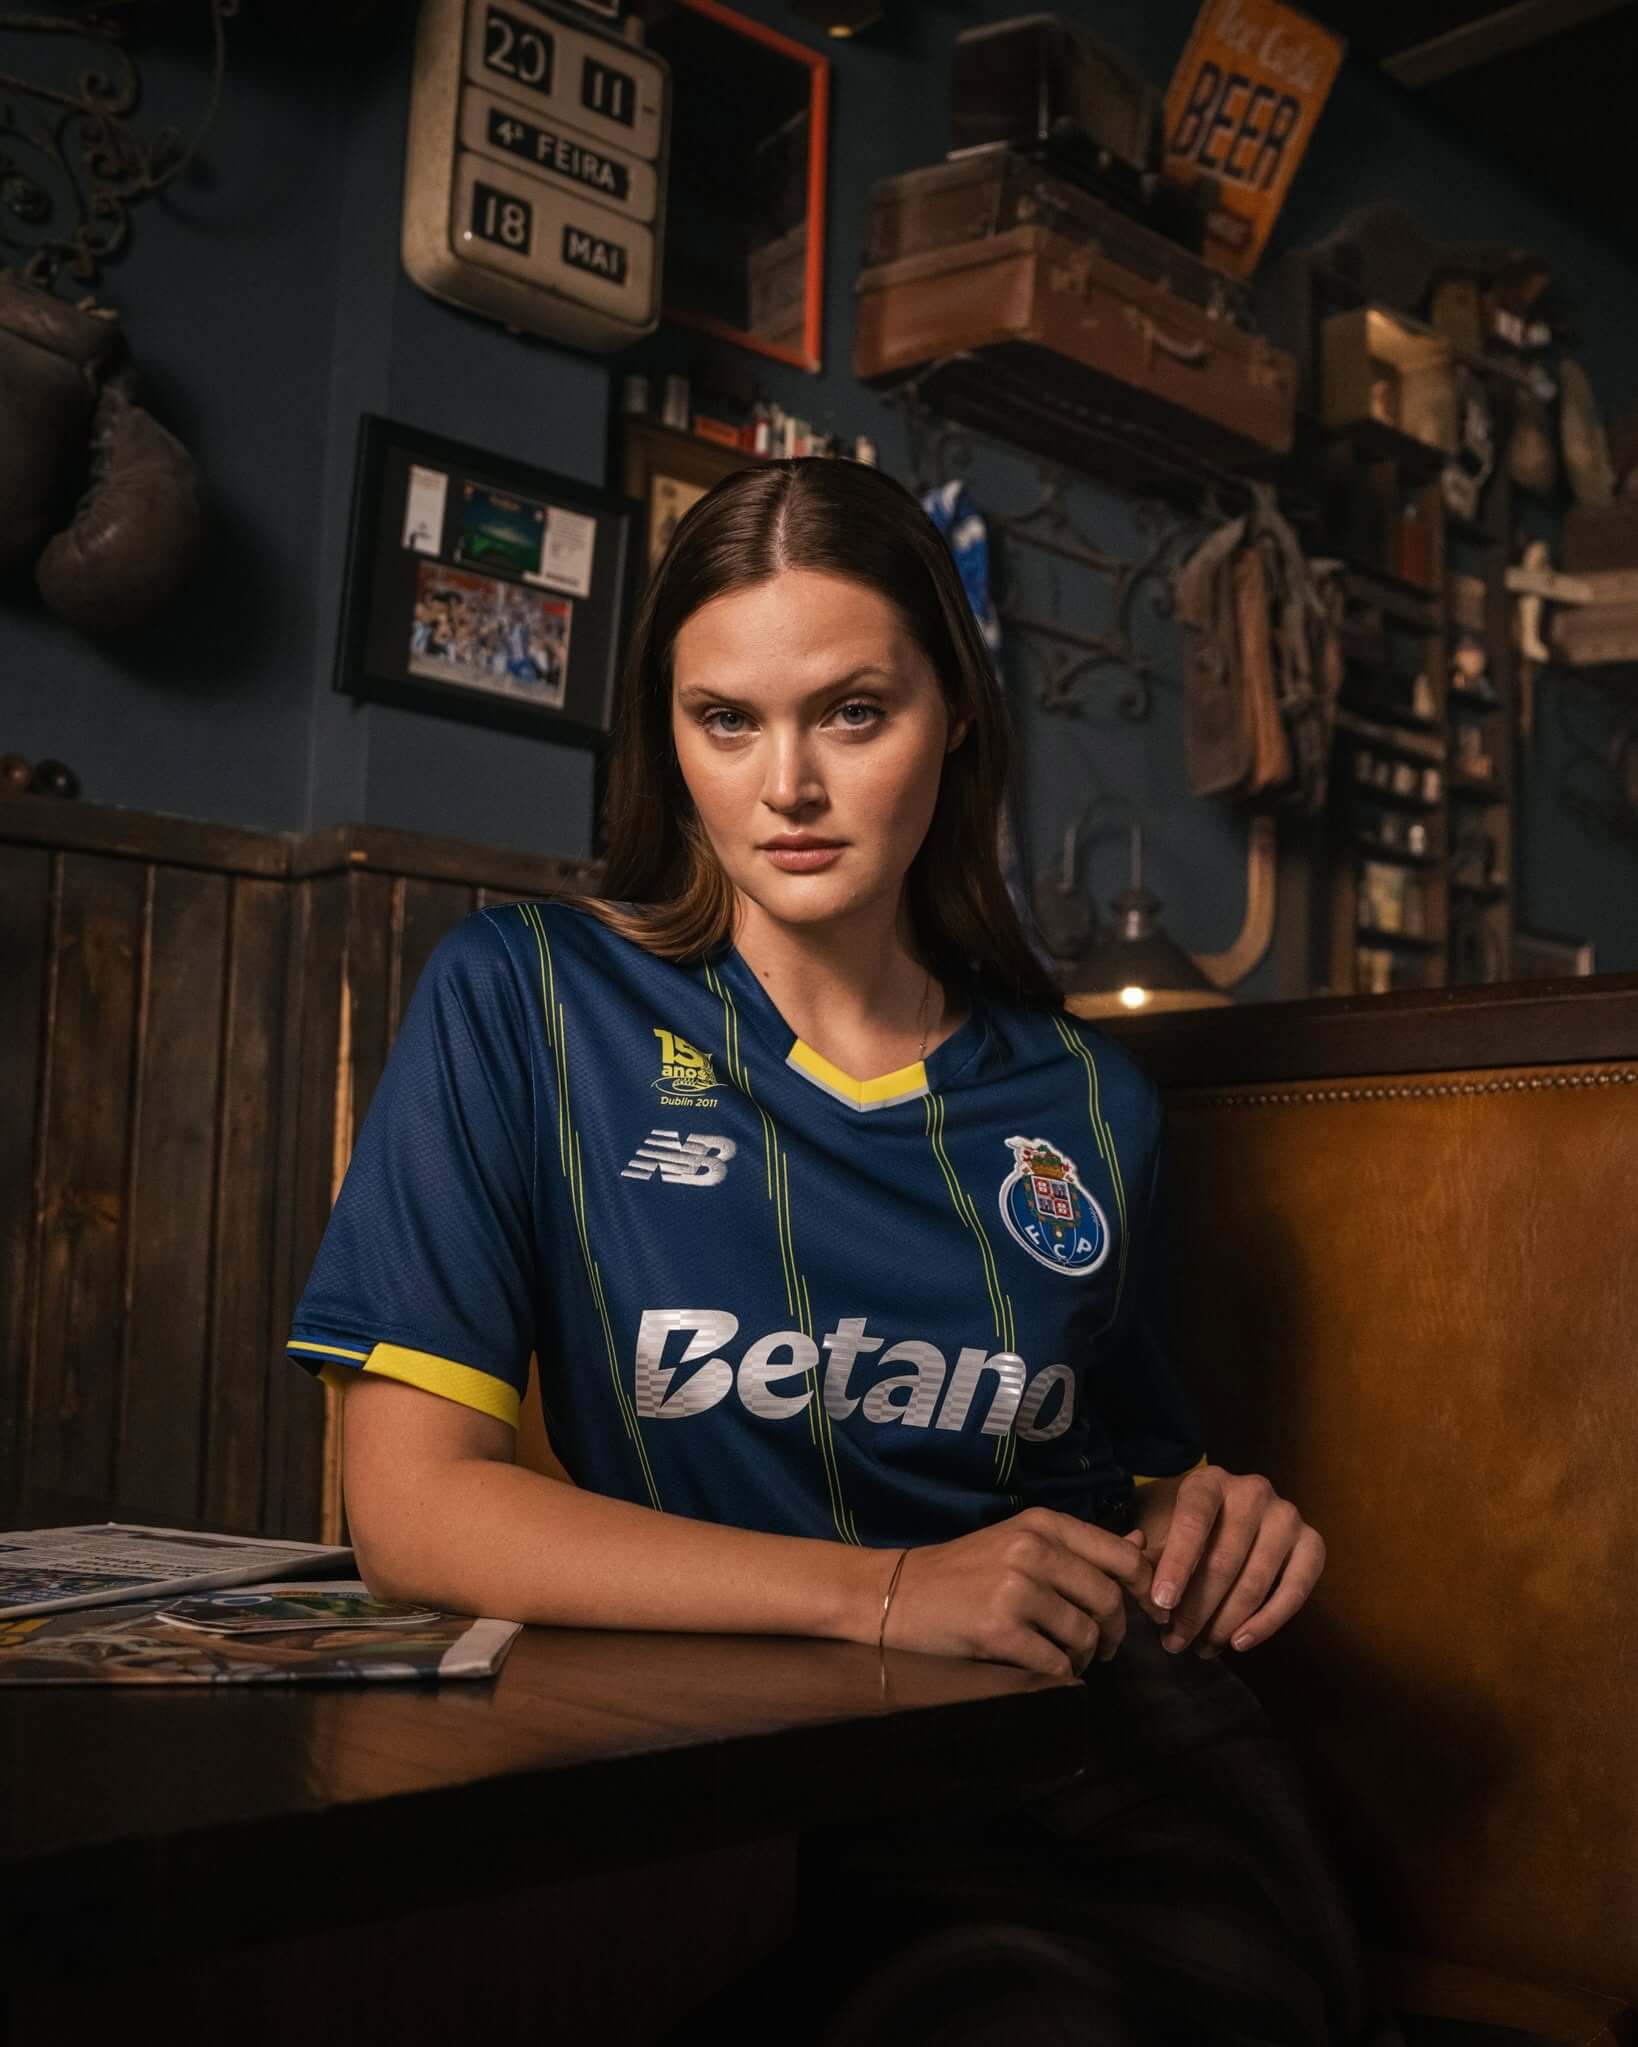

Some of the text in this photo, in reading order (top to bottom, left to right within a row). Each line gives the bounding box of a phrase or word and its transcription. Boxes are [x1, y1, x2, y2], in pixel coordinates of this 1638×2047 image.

[592, 71, 622, 117] 11
[1168, 60, 1303, 192] BEER
[537, 136, 615, 189] FEIRA
[484, 196, 619, 276] 18 MAI
[653, 1027, 705, 1067] 15
[662, 1064, 706, 1080] anos
[660, 1096, 718, 1108] Dublin 2011
[635, 1308, 1076, 1443] Betano
